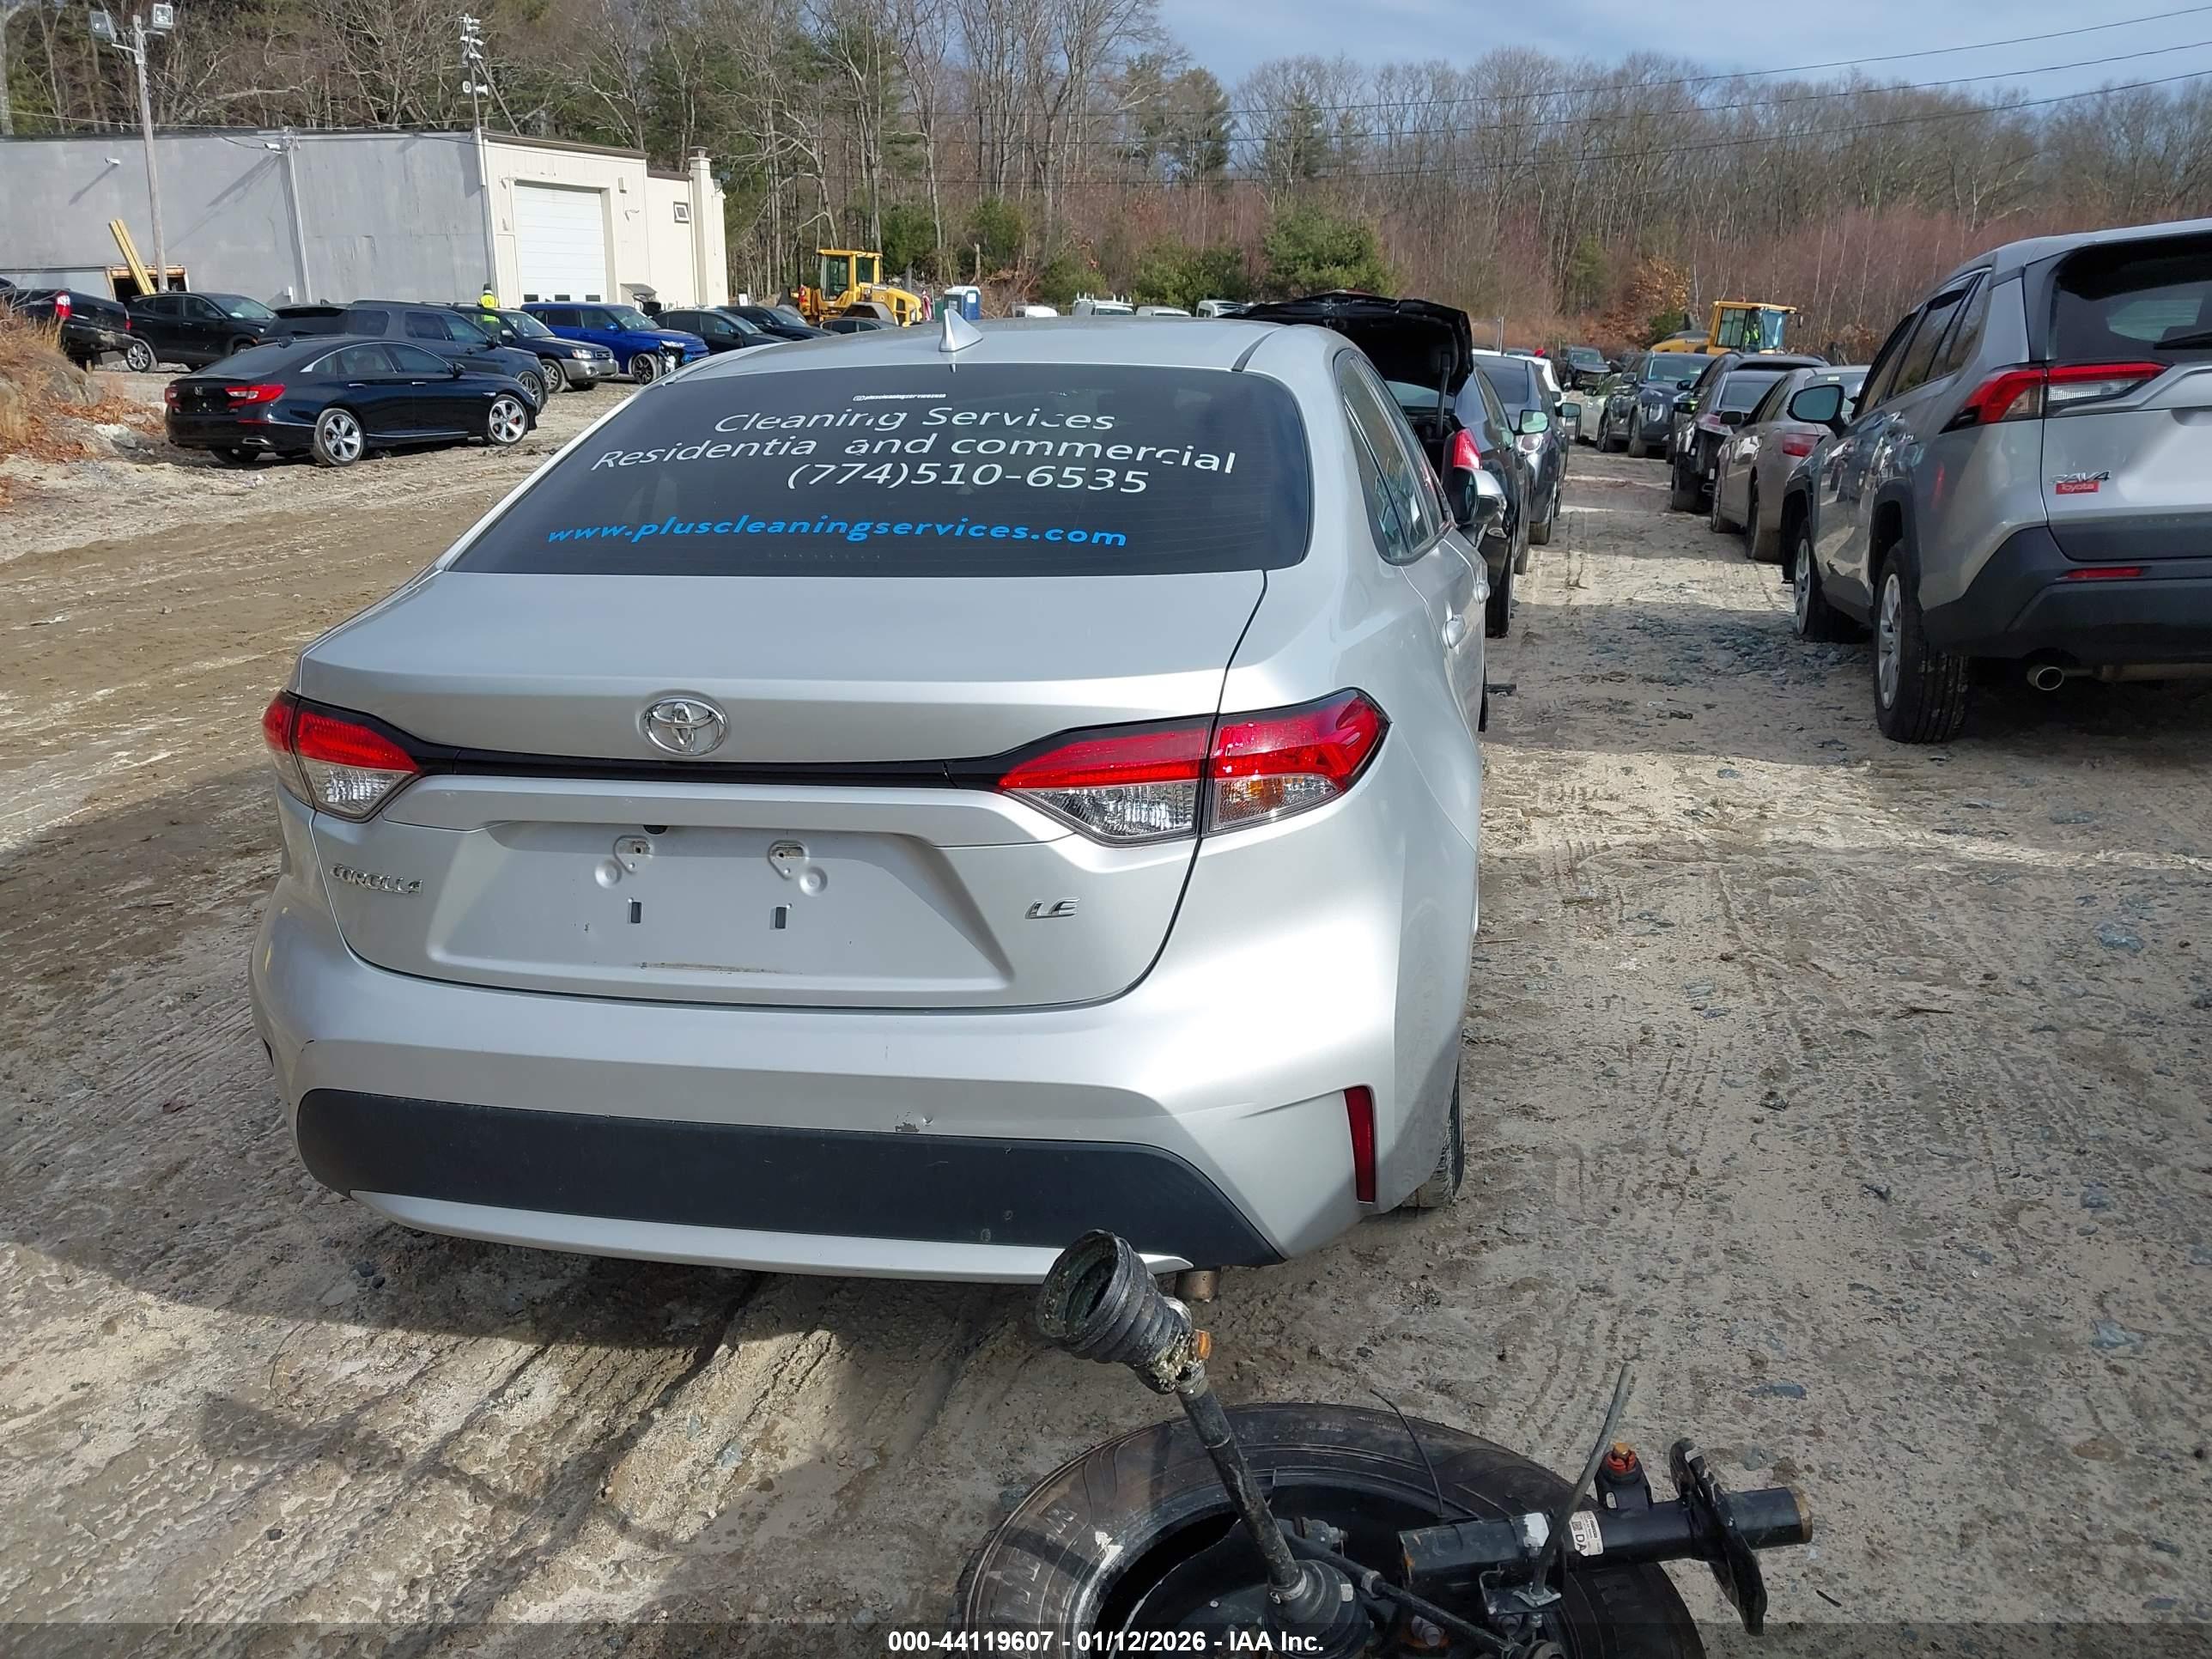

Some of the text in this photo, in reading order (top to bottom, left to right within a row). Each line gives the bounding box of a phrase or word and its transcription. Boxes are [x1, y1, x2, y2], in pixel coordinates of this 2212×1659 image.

[714, 407, 1116, 431] Cleaning Services
[844, 432, 939, 455] and
[950, 438, 1237, 474] commercial
[787, 462, 1150, 494] (774)510-6535
[2061, 483, 2095, 493] Toyota
[548, 514, 1127, 547] www.pluscleaningservices.com
[1024, 896, 1080, 921] LE
